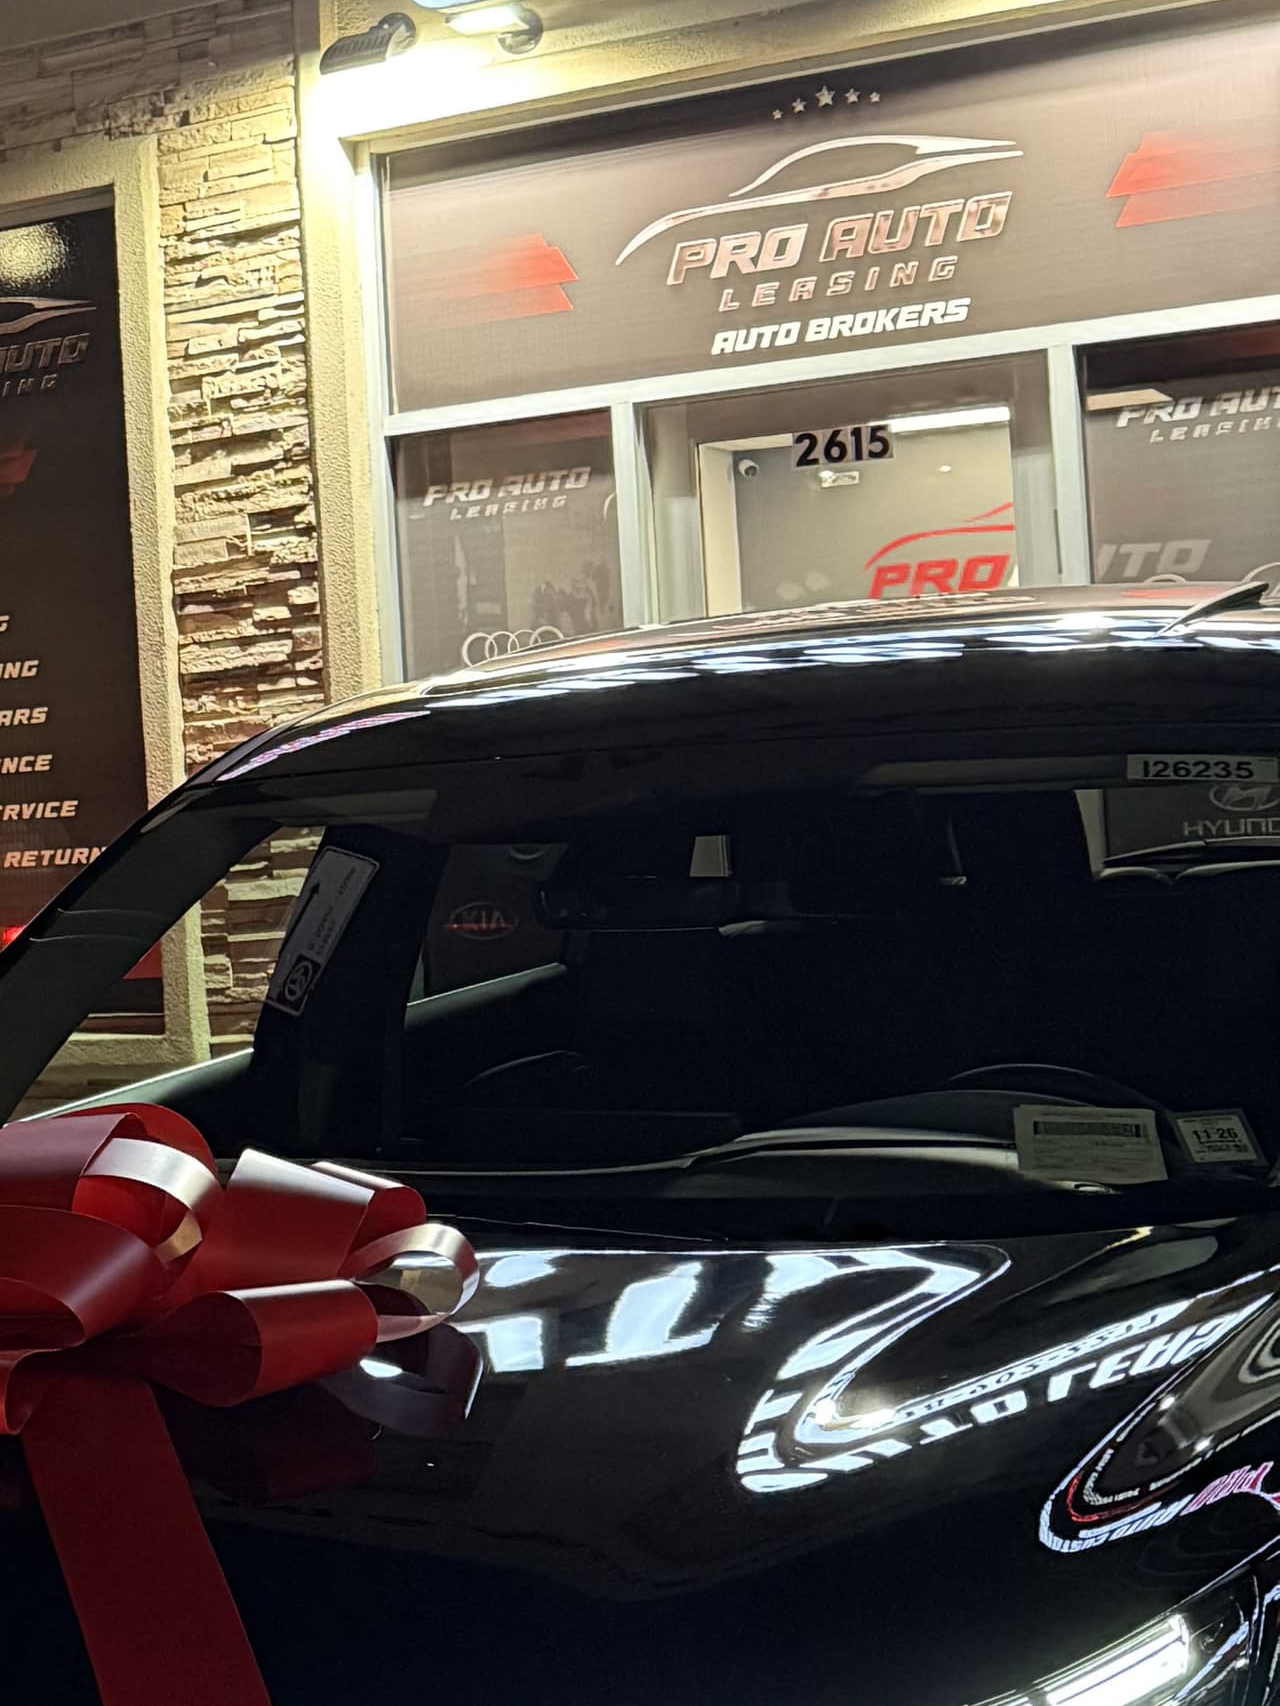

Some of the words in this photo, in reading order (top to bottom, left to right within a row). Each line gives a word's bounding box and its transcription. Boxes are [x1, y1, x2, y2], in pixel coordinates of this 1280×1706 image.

[667, 224, 809, 286] PRO
[820, 191, 1013, 263] AUTO
[718, 255, 959, 312] LEASING
[711, 321, 801, 355] AUTO
[805, 297, 972, 343] BROKERS
[1116, 397, 1203, 428] PRO
[1150, 417, 1280, 444] LEASIN
[794, 429, 891, 468] 2615
[423, 479, 492, 507] PRO
[498, 467, 592, 497] AUTO
[450, 495, 568, 520] LEASING
[869, 555, 1011, 600] PRO
